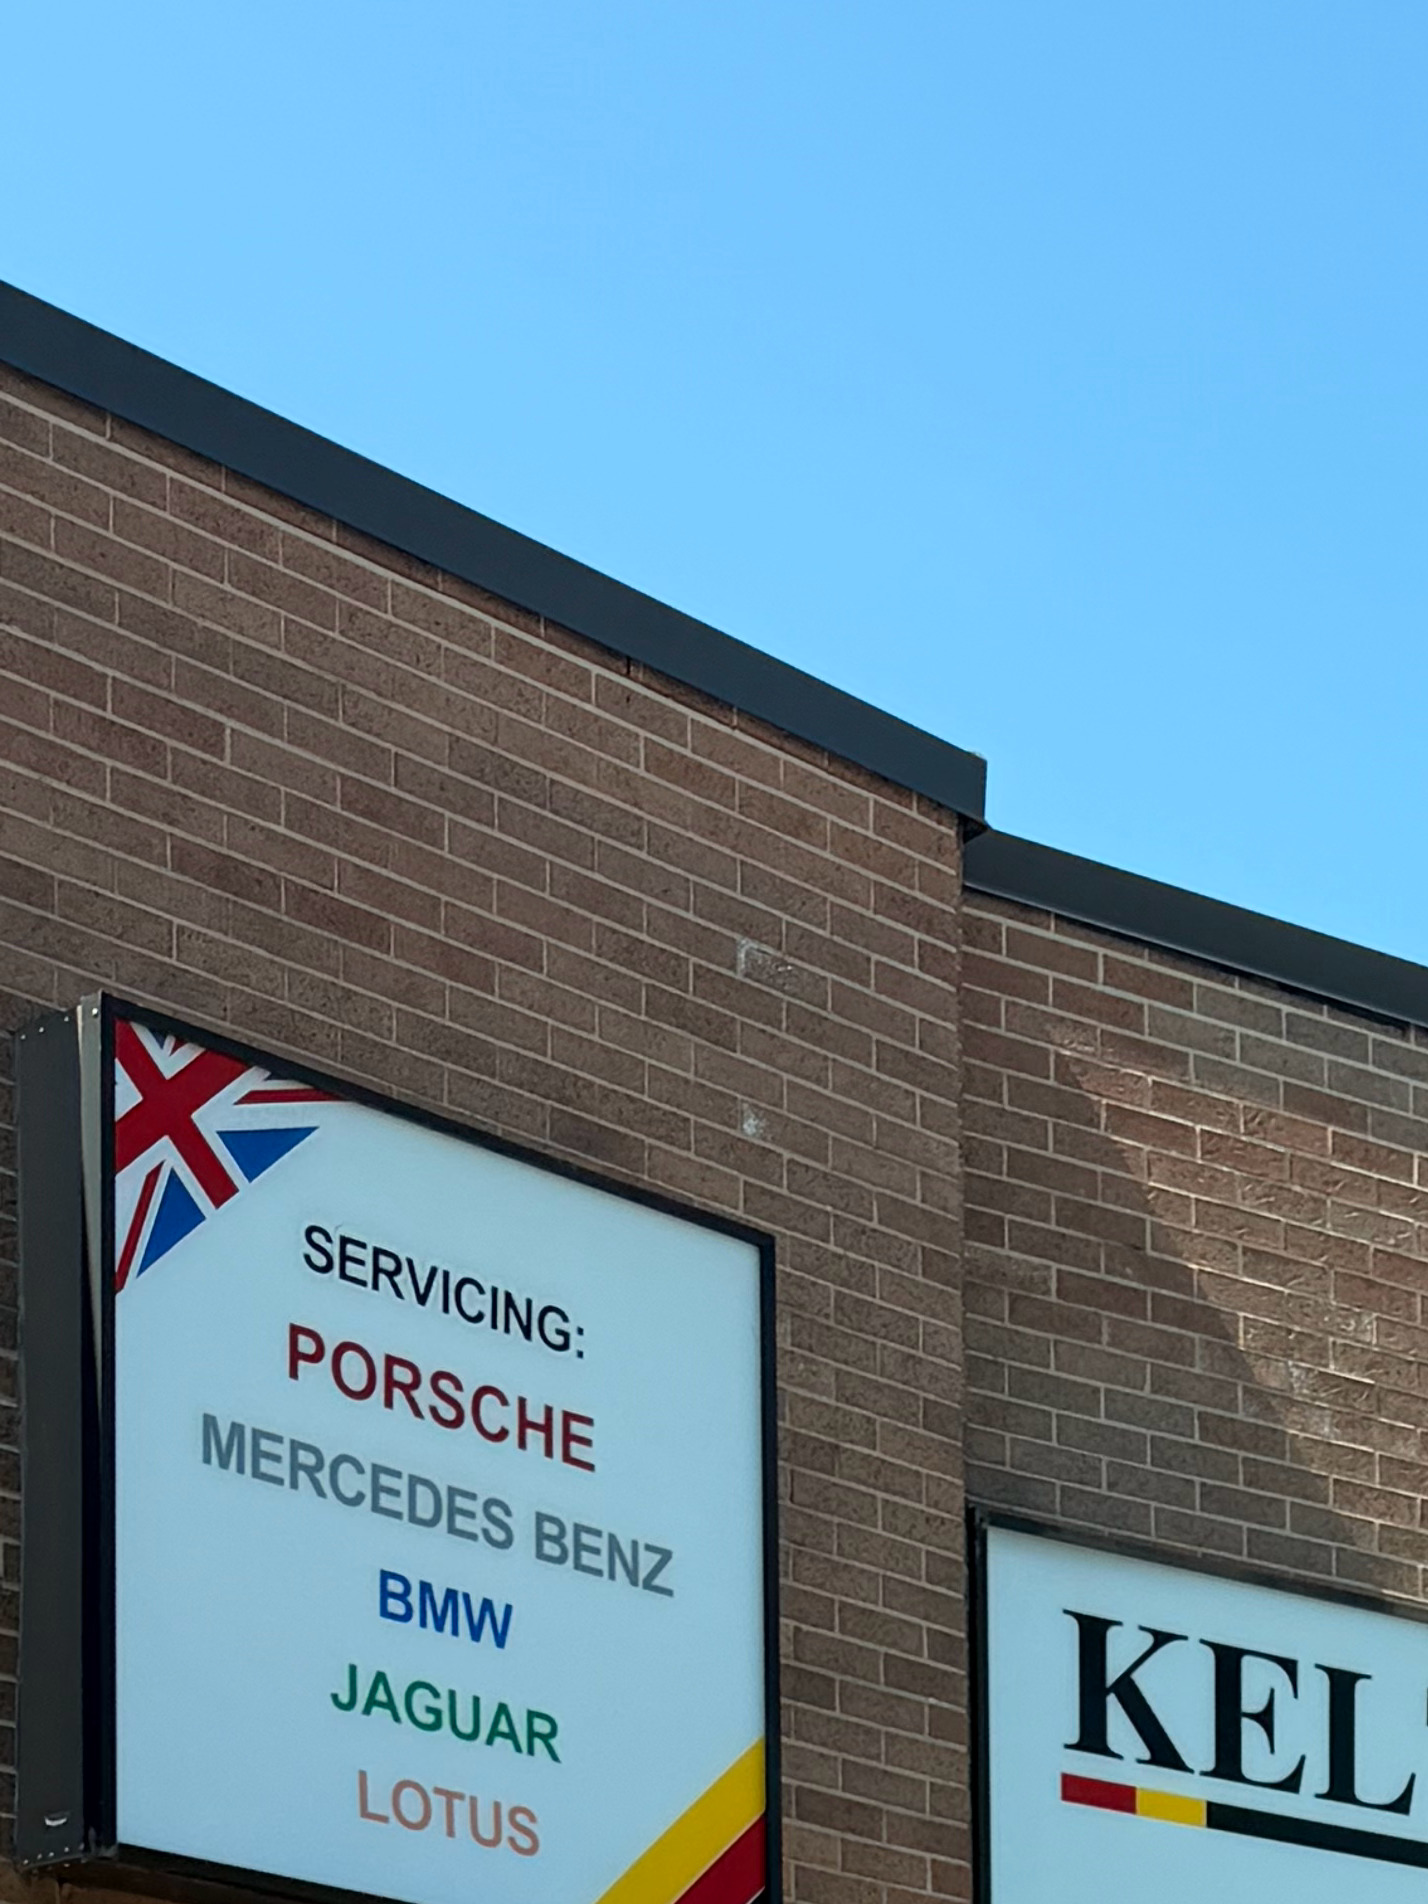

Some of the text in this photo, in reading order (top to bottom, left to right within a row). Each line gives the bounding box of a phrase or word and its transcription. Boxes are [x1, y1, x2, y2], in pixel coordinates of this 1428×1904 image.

[302, 1226, 586, 1358] SERVICING:
[287, 1323, 595, 1471] PORSCHE
[200, 1412, 674, 1597] MERCEDES BENZ
[378, 1569, 513, 1649] BMW
[330, 1663, 561, 1763] JAGUAR
[356, 1769, 541, 1857] LOTUS
